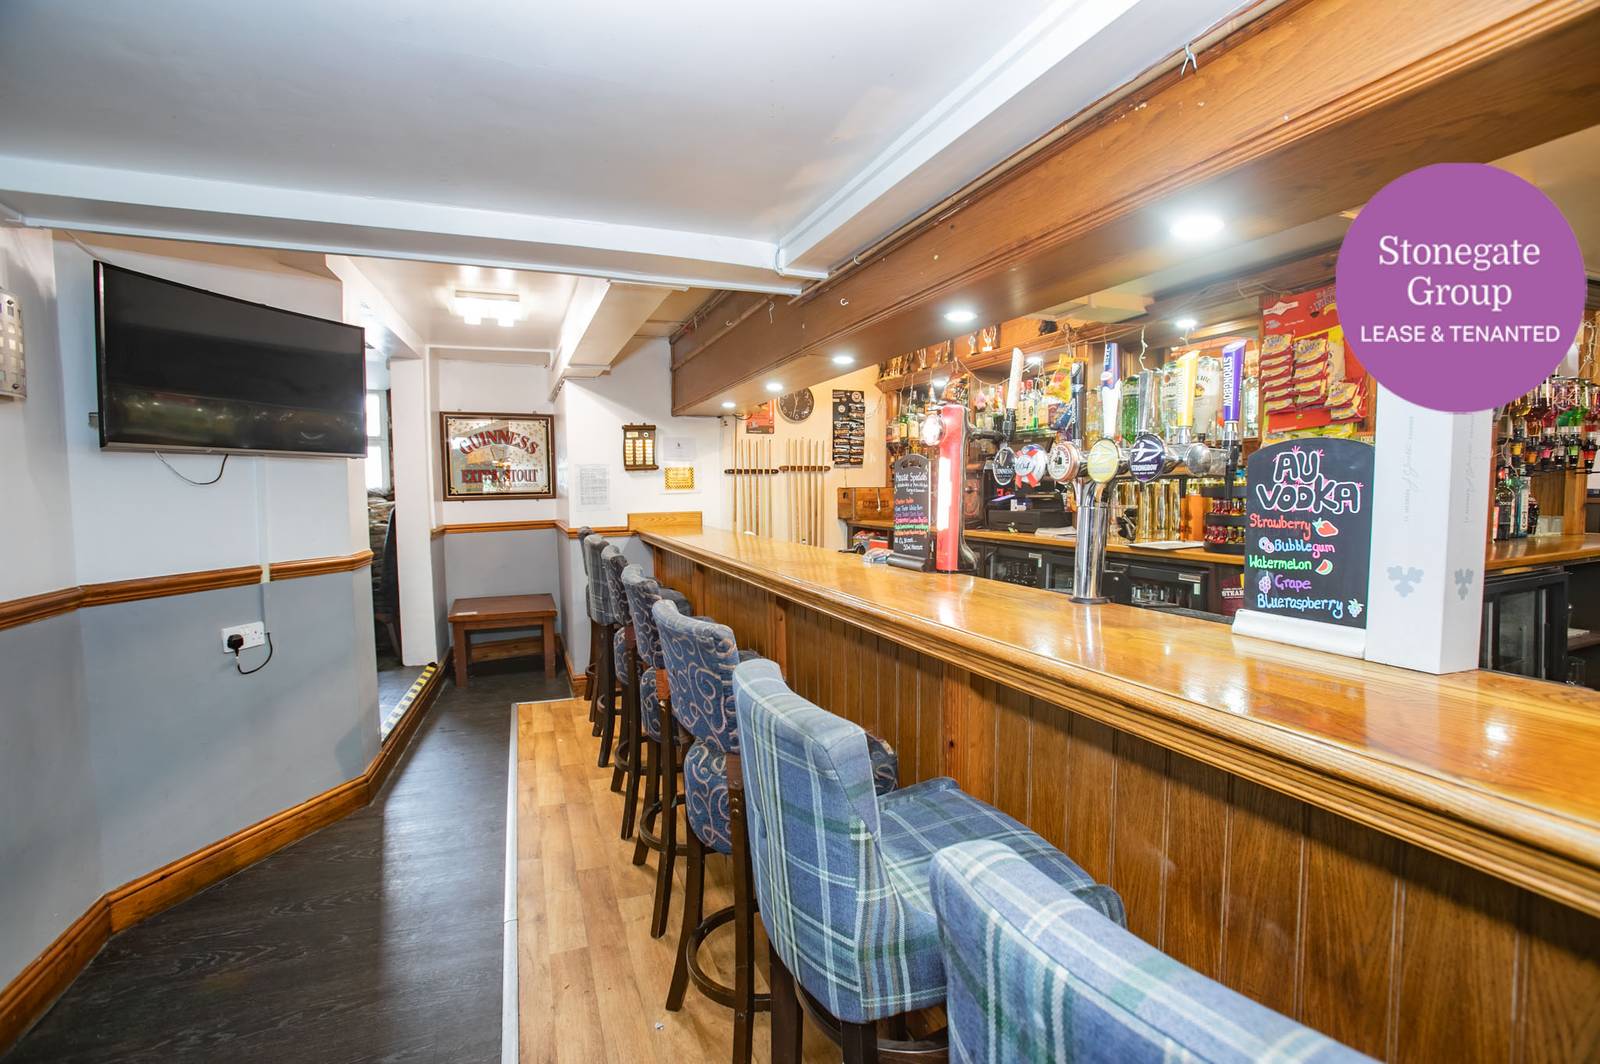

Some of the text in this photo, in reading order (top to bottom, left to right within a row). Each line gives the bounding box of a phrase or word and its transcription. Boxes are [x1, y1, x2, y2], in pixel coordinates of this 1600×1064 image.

[1223, 356, 1234, 407] STRONGBOW
[460, 429, 539, 454] GUINNESS
[1273, 450, 1319, 484] AU
[1256, 473, 1361, 514] VODKA
[1249, 512, 1312, 541] Strawberry
[1274, 538, 1336, 558] Bubblegum
[1248, 554, 1313, 571] Watermelon
[1274, 574, 1312, 592] Grape
[1257, 594, 1344, 619] Blueraspberry
